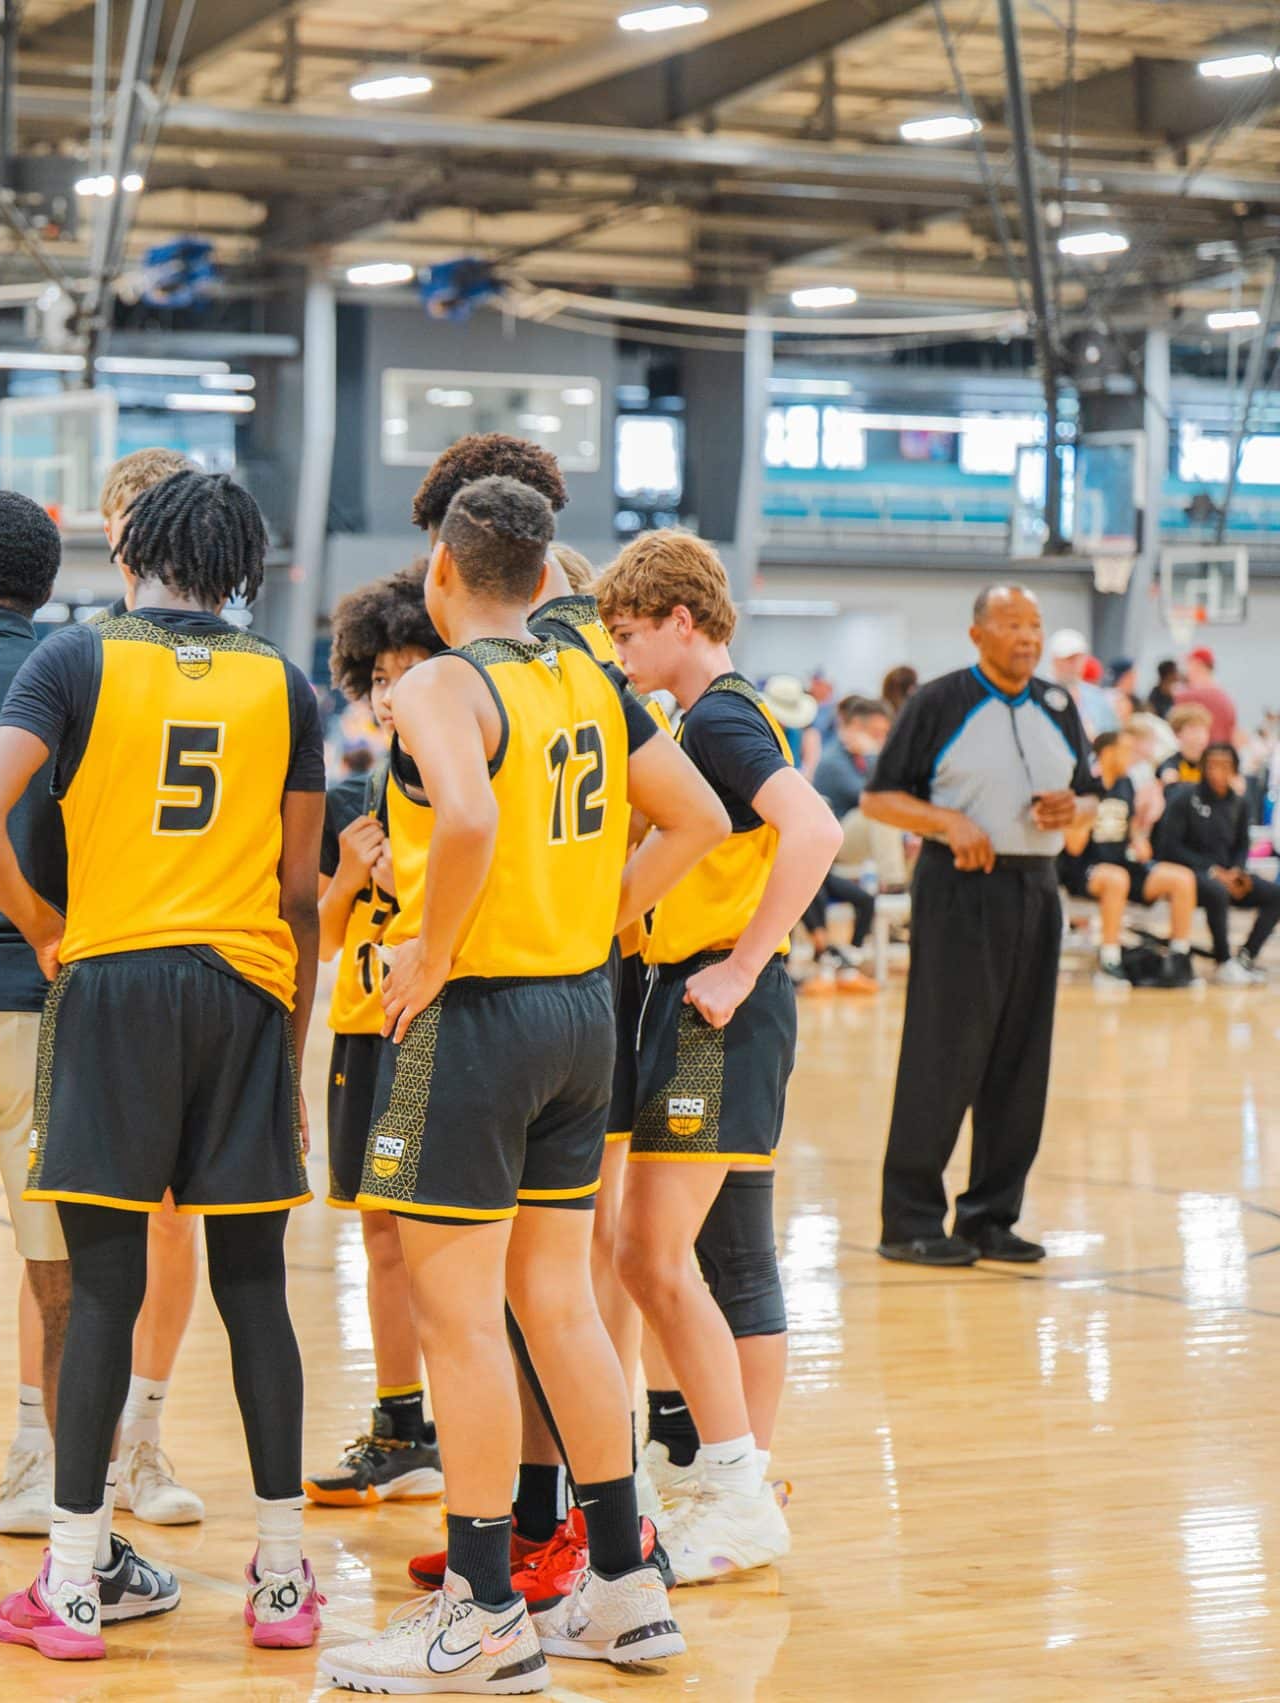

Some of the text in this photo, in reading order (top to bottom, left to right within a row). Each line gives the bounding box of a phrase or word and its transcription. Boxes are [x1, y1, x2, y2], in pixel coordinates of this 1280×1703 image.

[151, 720, 225, 836] 5
[543, 719, 608, 845] 12
[669, 1097, 705, 1109] PRO
[376, 1135, 406, 1150] PRO
